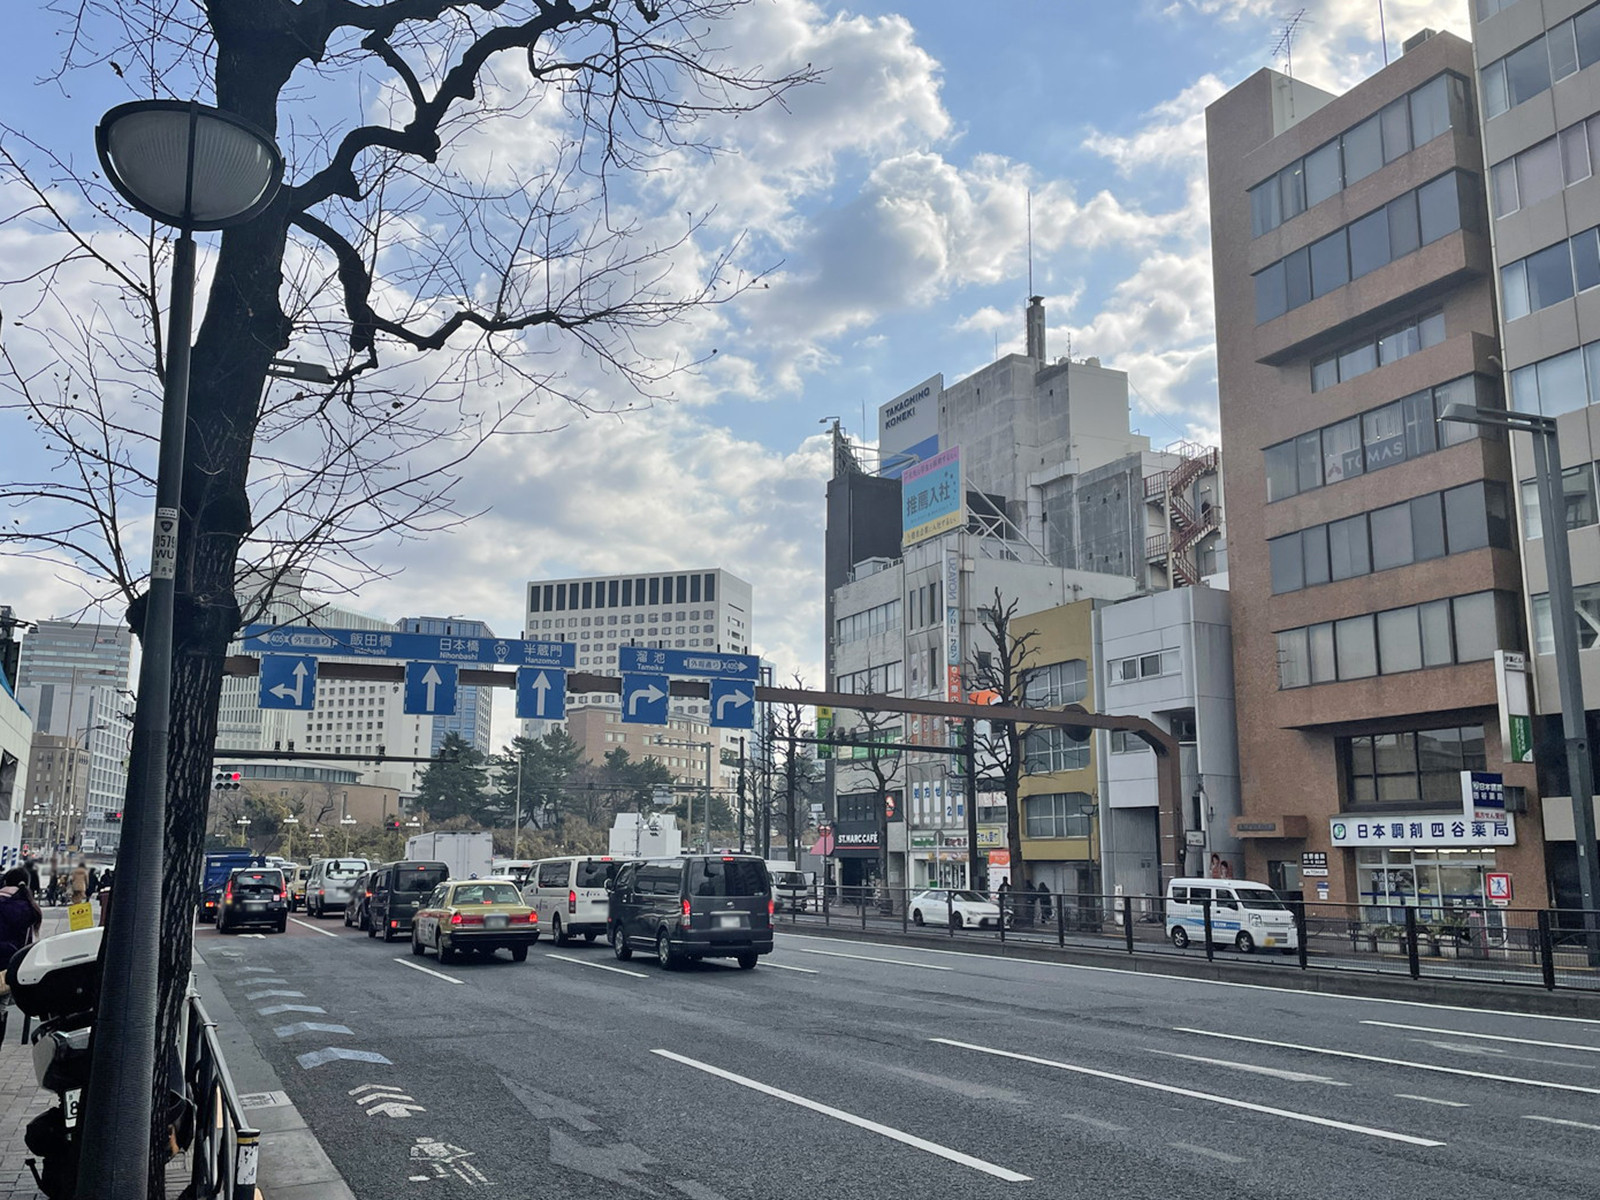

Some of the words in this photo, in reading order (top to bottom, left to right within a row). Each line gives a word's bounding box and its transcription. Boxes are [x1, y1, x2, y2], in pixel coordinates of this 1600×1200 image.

[1345, 441, 1404, 471] TOMAS
[350, 632, 393, 648] 飯田橋
[439, 637, 480, 653] 日本橋
[439, 651, 479, 661] Nihonbashi
[496, 646, 507, 655] 20
[523, 642, 563, 658] 半蔵門
[524, 656, 561, 666] Hanzomon
[636, 662, 664, 672] Tameike
[1356, 821, 1510, 839] 日本調剤四谷薬局
